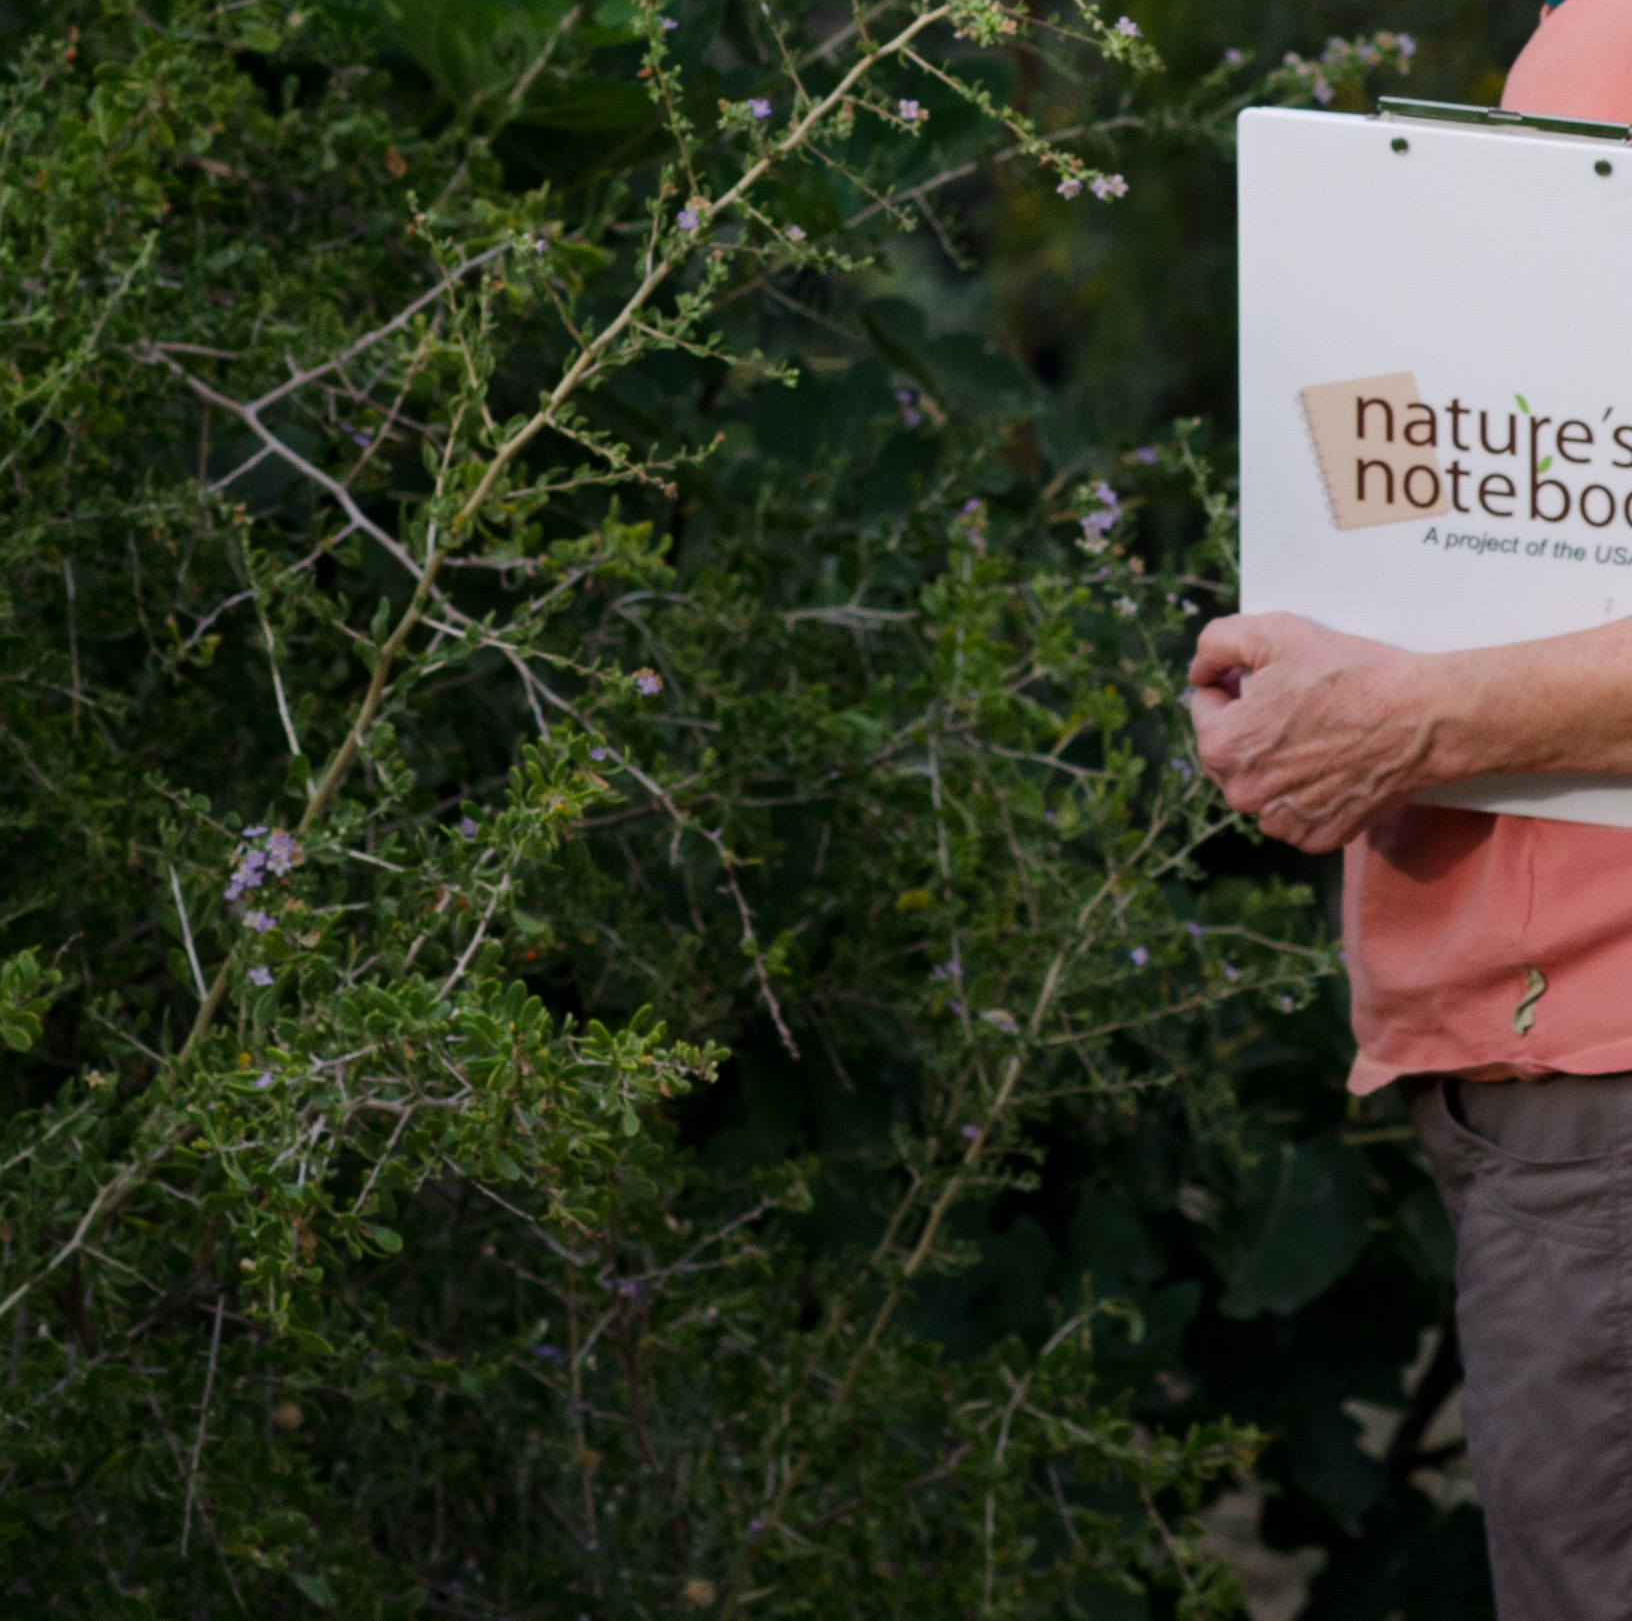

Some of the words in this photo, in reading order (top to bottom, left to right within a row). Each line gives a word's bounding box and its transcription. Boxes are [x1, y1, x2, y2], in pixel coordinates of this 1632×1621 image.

[1422, 527, 1440, 546] A
[1444, 531, 1520, 556] project
[1525, 539, 1548, 558] of
[1553, 542, 1587, 562] the
